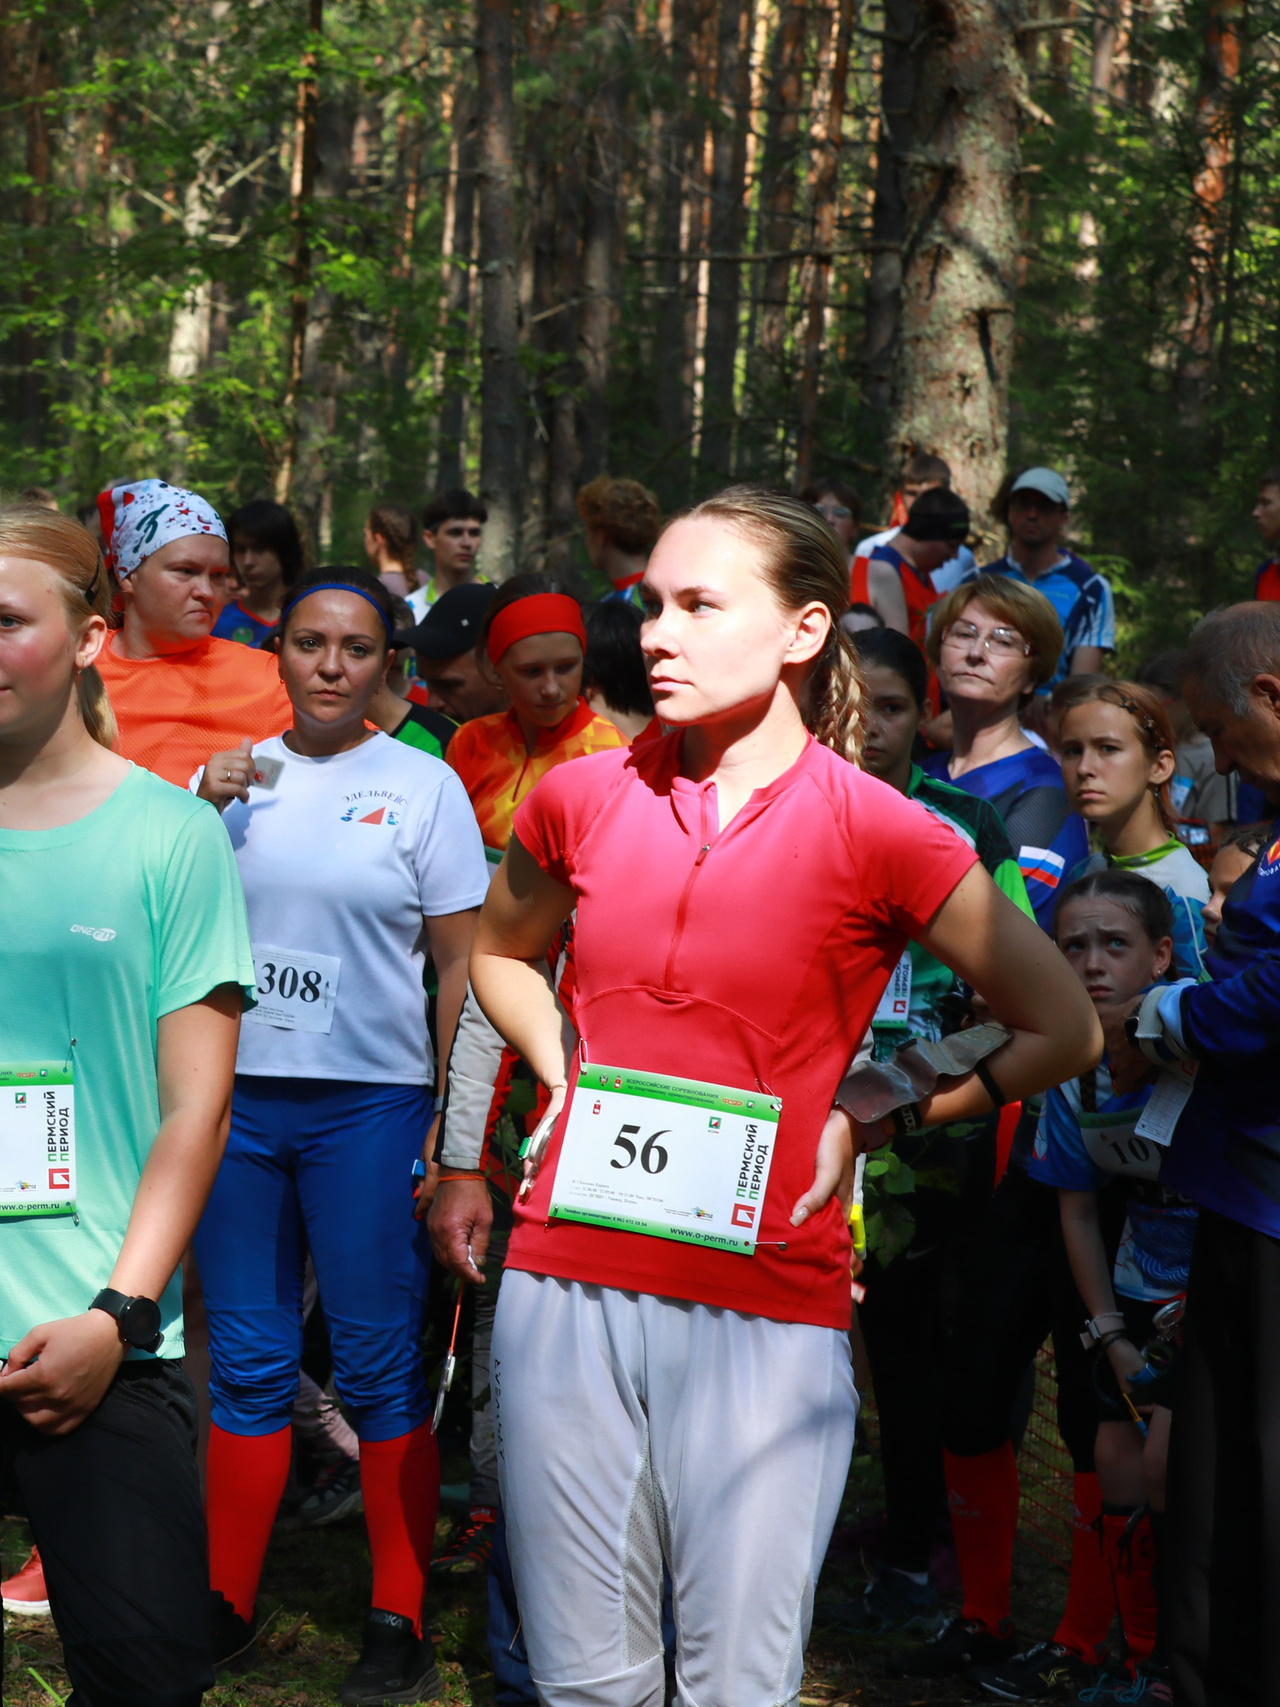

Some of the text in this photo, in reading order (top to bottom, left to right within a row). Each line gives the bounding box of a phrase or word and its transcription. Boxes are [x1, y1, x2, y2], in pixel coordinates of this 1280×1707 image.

[257, 962, 322, 1003] 308
[671, 1085, 719, 1099] СОРЕВНОВАНИЯ
[44, 1091, 57, 1162] ПЕРМСКИЙ
[58, 1107, 70, 1162] ПЕРИОД
[610, 1124, 673, 1175] 56
[736, 1124, 758, 1198] ПЕРМСКИЙ
[748, 1144, 769, 1200] ПЕРИОД
[670, 1227, 738, 1247] www.o-perm.ru
